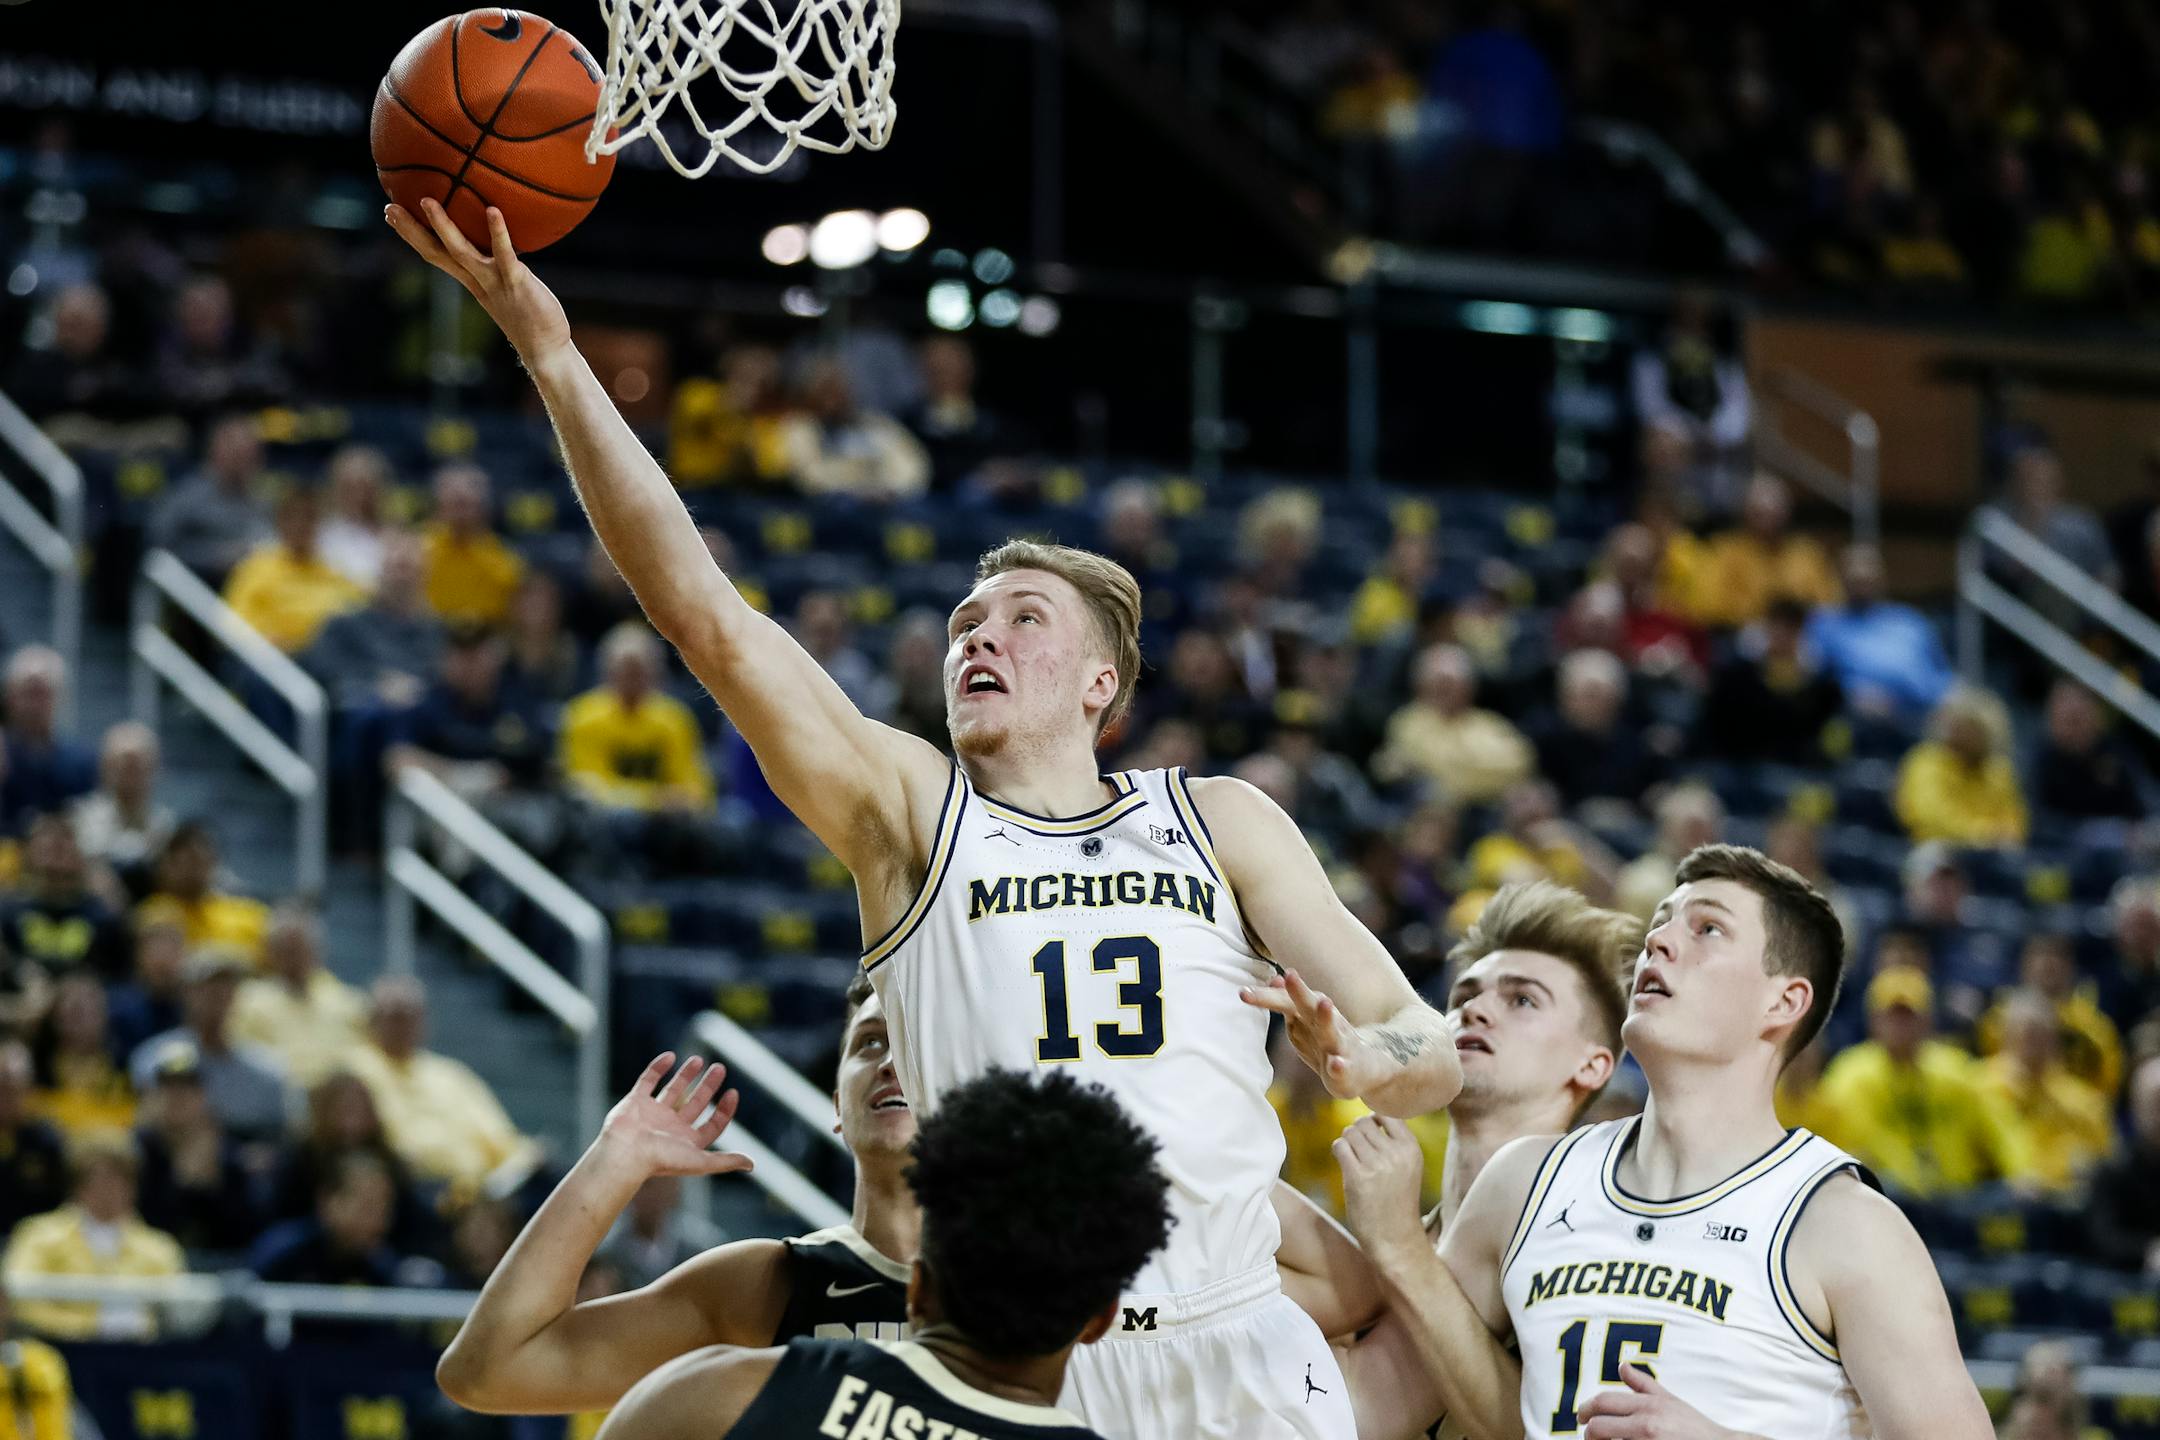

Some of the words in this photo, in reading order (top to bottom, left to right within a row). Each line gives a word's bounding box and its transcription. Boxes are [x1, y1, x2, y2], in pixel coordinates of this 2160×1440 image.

[968, 871, 1217, 925] MICHIGAN
[1031, 934, 1165, 1063] 13
[1121, 1306, 1158, 1331] M
[1524, 1260, 1733, 1323] MICHIGAN
